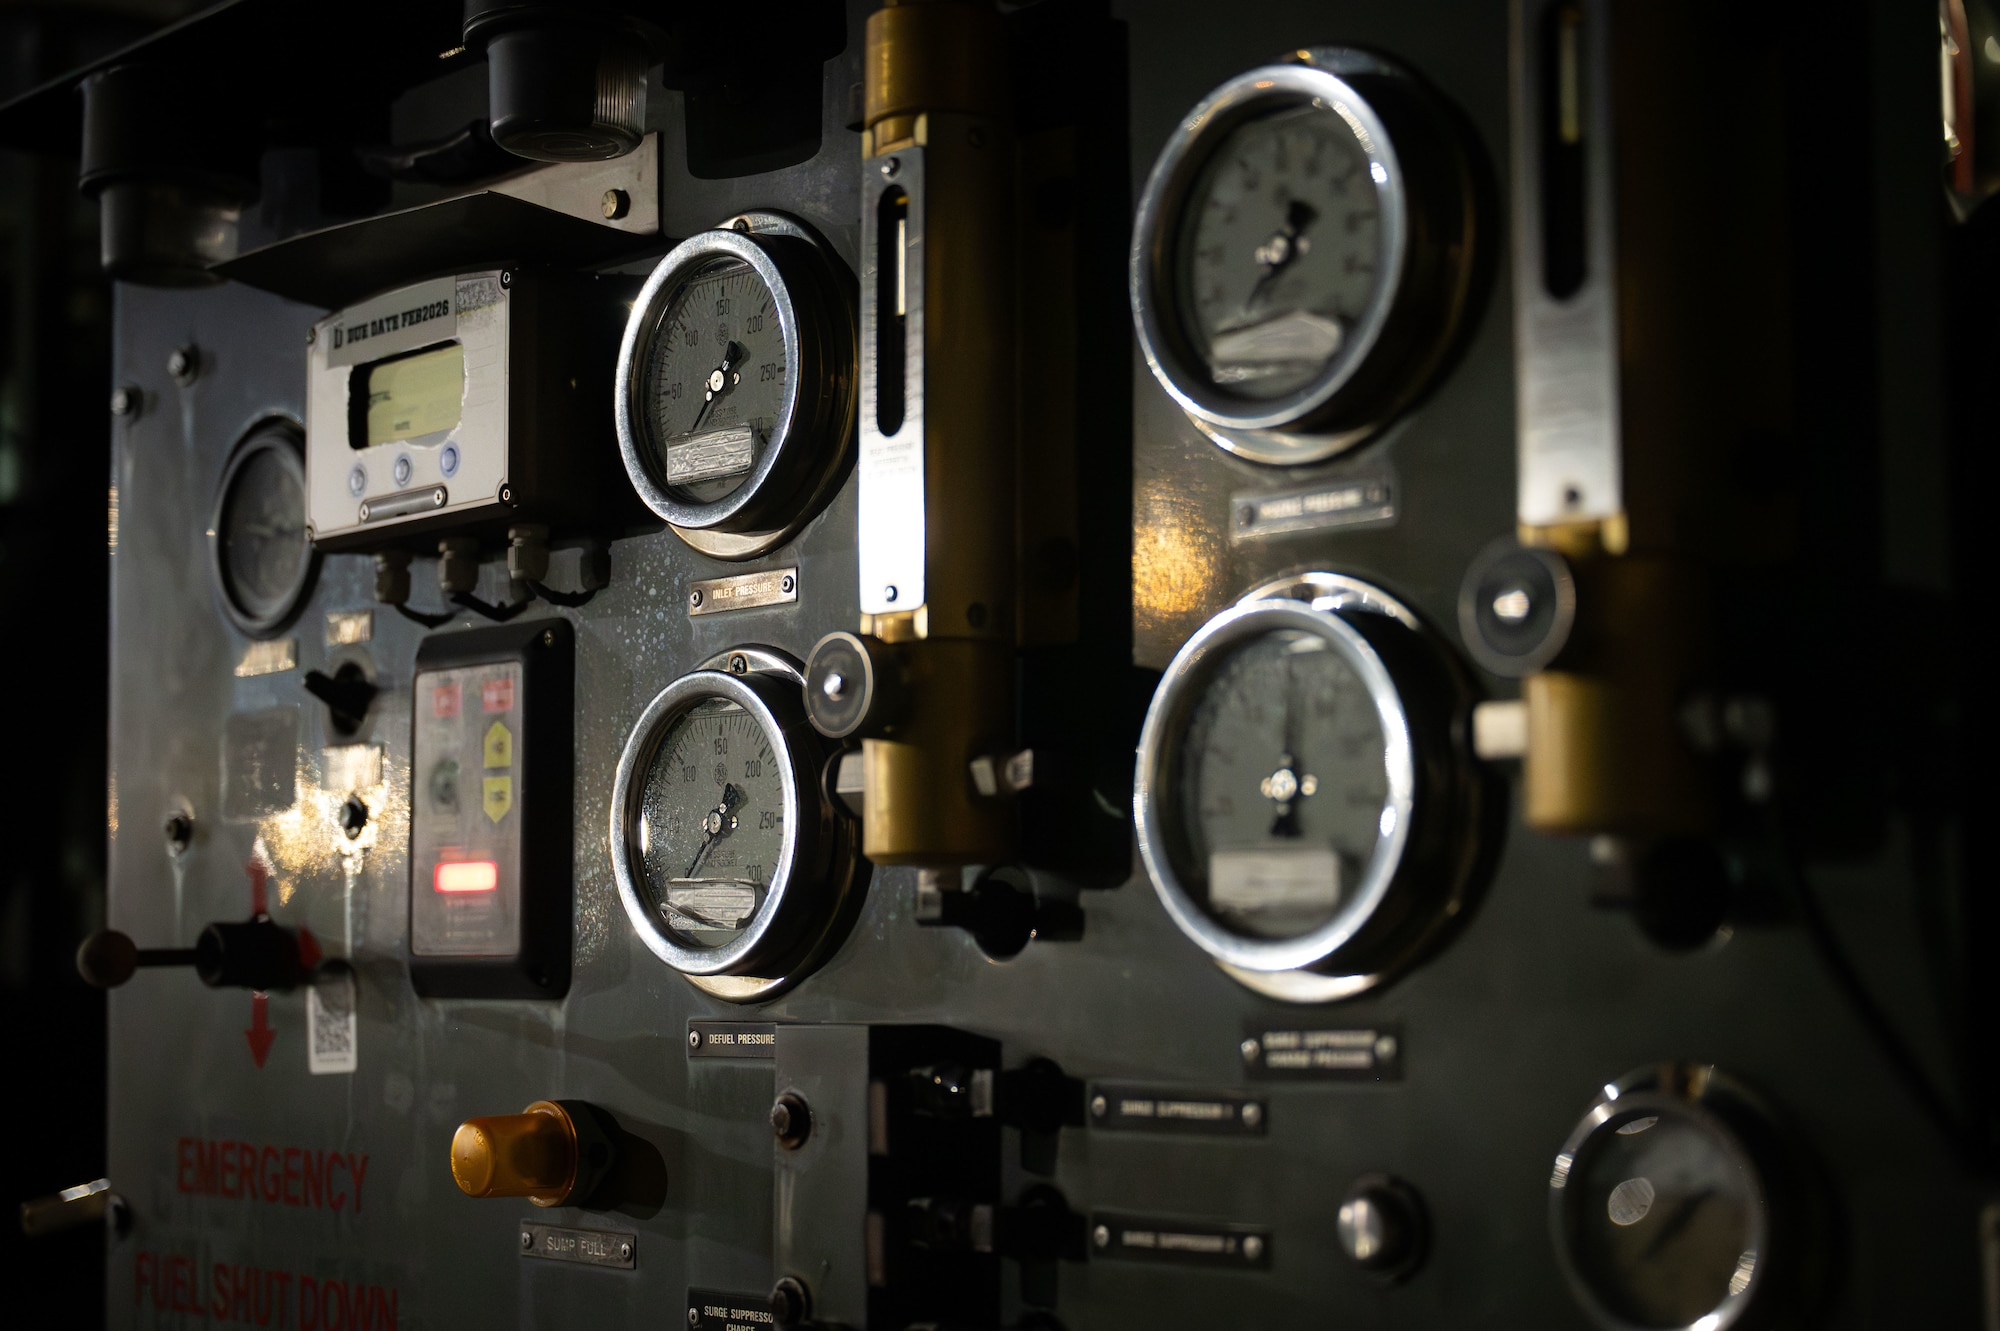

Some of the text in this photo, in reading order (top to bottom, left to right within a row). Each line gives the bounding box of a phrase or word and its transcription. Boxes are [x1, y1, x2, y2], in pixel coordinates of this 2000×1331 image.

[716, 299, 730, 316] 150
[347, 324, 369, 344] DUE
[371, 315, 399, 337] DATE
[401, 300, 449, 328] FEB2026
[747, 315, 763, 334] 200
[685, 331, 699, 347] 100
[760, 363, 777, 382] 250
[671, 383, 682, 399] 50
[712, 582, 772, 600] INLET PRESSURE
[714, 737, 728, 756] 150
[683, 765, 696, 783] 100
[745, 760, 761, 778] 200
[759, 811, 775, 830] 250
[746, 865, 762, 881] 300
[709, 1034, 775, 1045] DEFUEL PRESSURE
[177, 1136, 368, 1214] EMERGENCY
[547, 1236, 607, 1256] SUMP FULL
[134, 1251, 398, 1331] FUEL SHUT DOWN
[704, 1306, 774, 1324] SURGE SUPPRESSO
